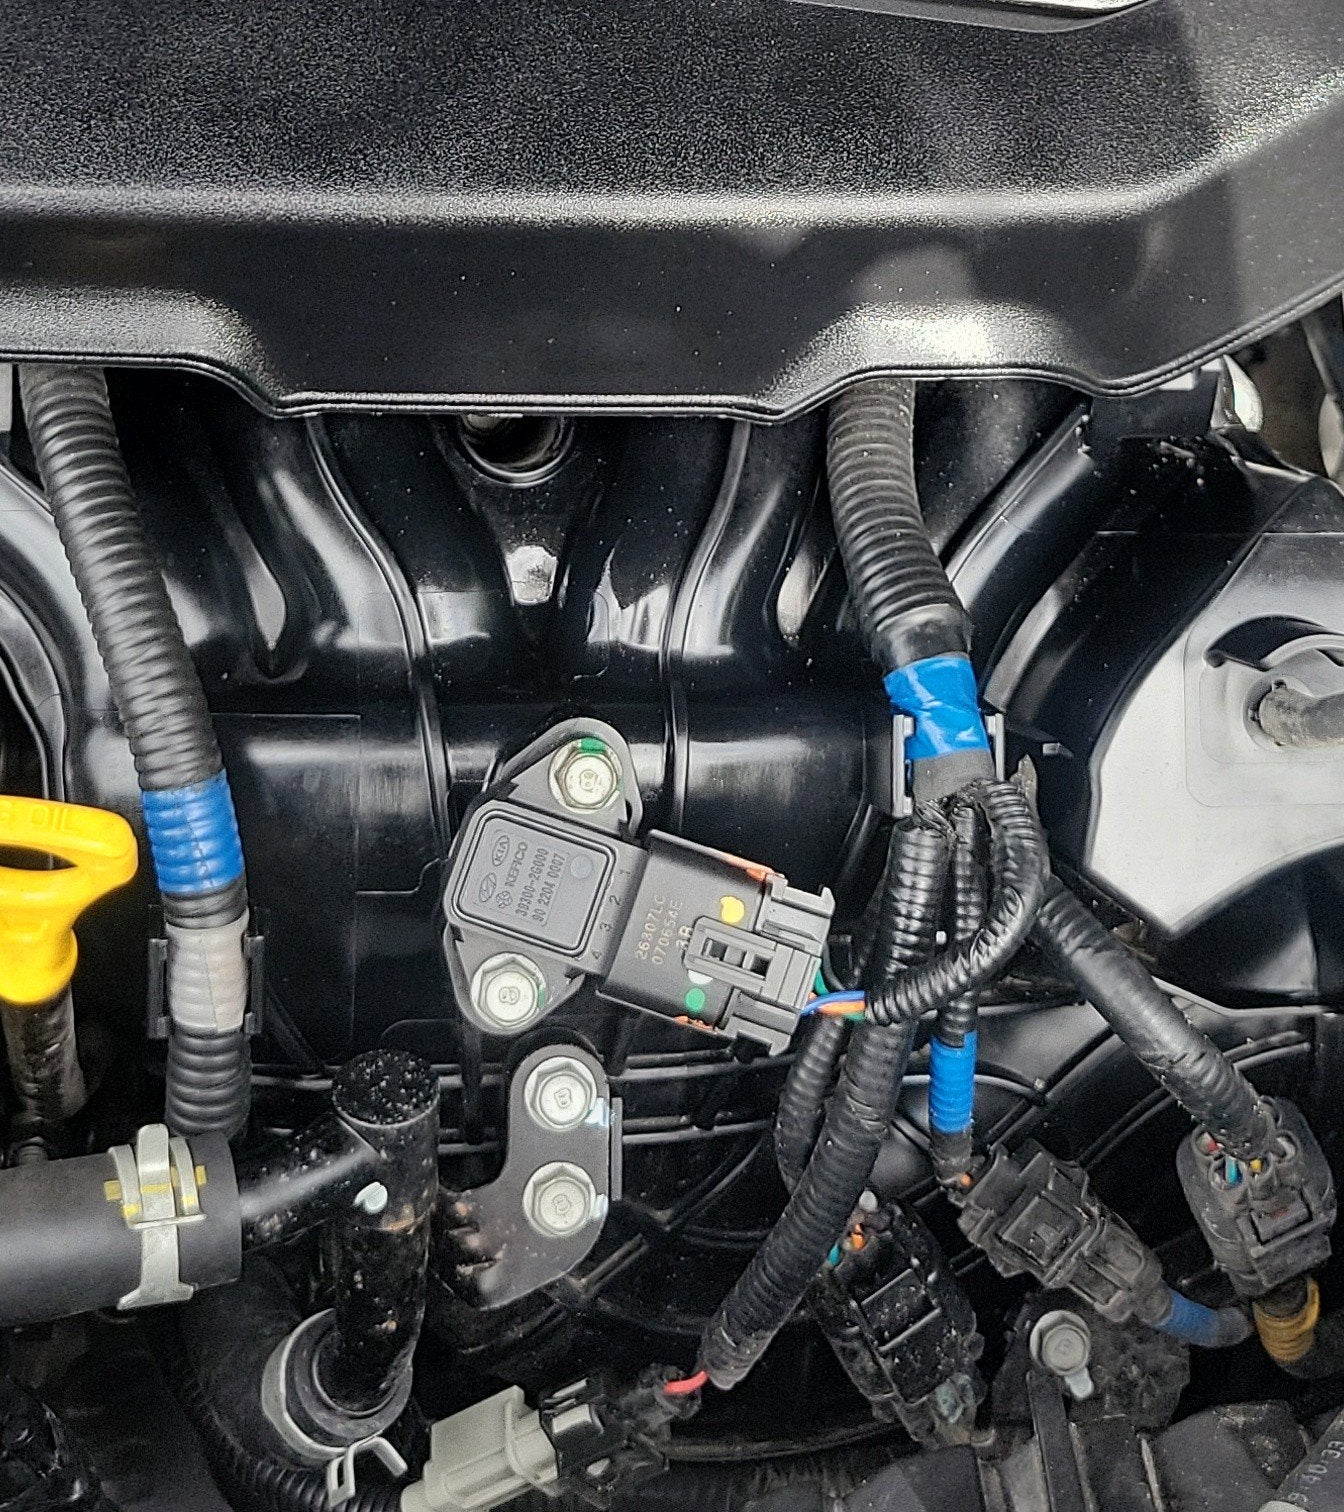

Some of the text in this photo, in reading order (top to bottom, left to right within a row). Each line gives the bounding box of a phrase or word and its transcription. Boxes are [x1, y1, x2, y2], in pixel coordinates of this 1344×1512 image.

[29, 804, 79, 834] OIL
[537, 881, 556, 906] 2204
[547, 852, 566, 879] 0007
